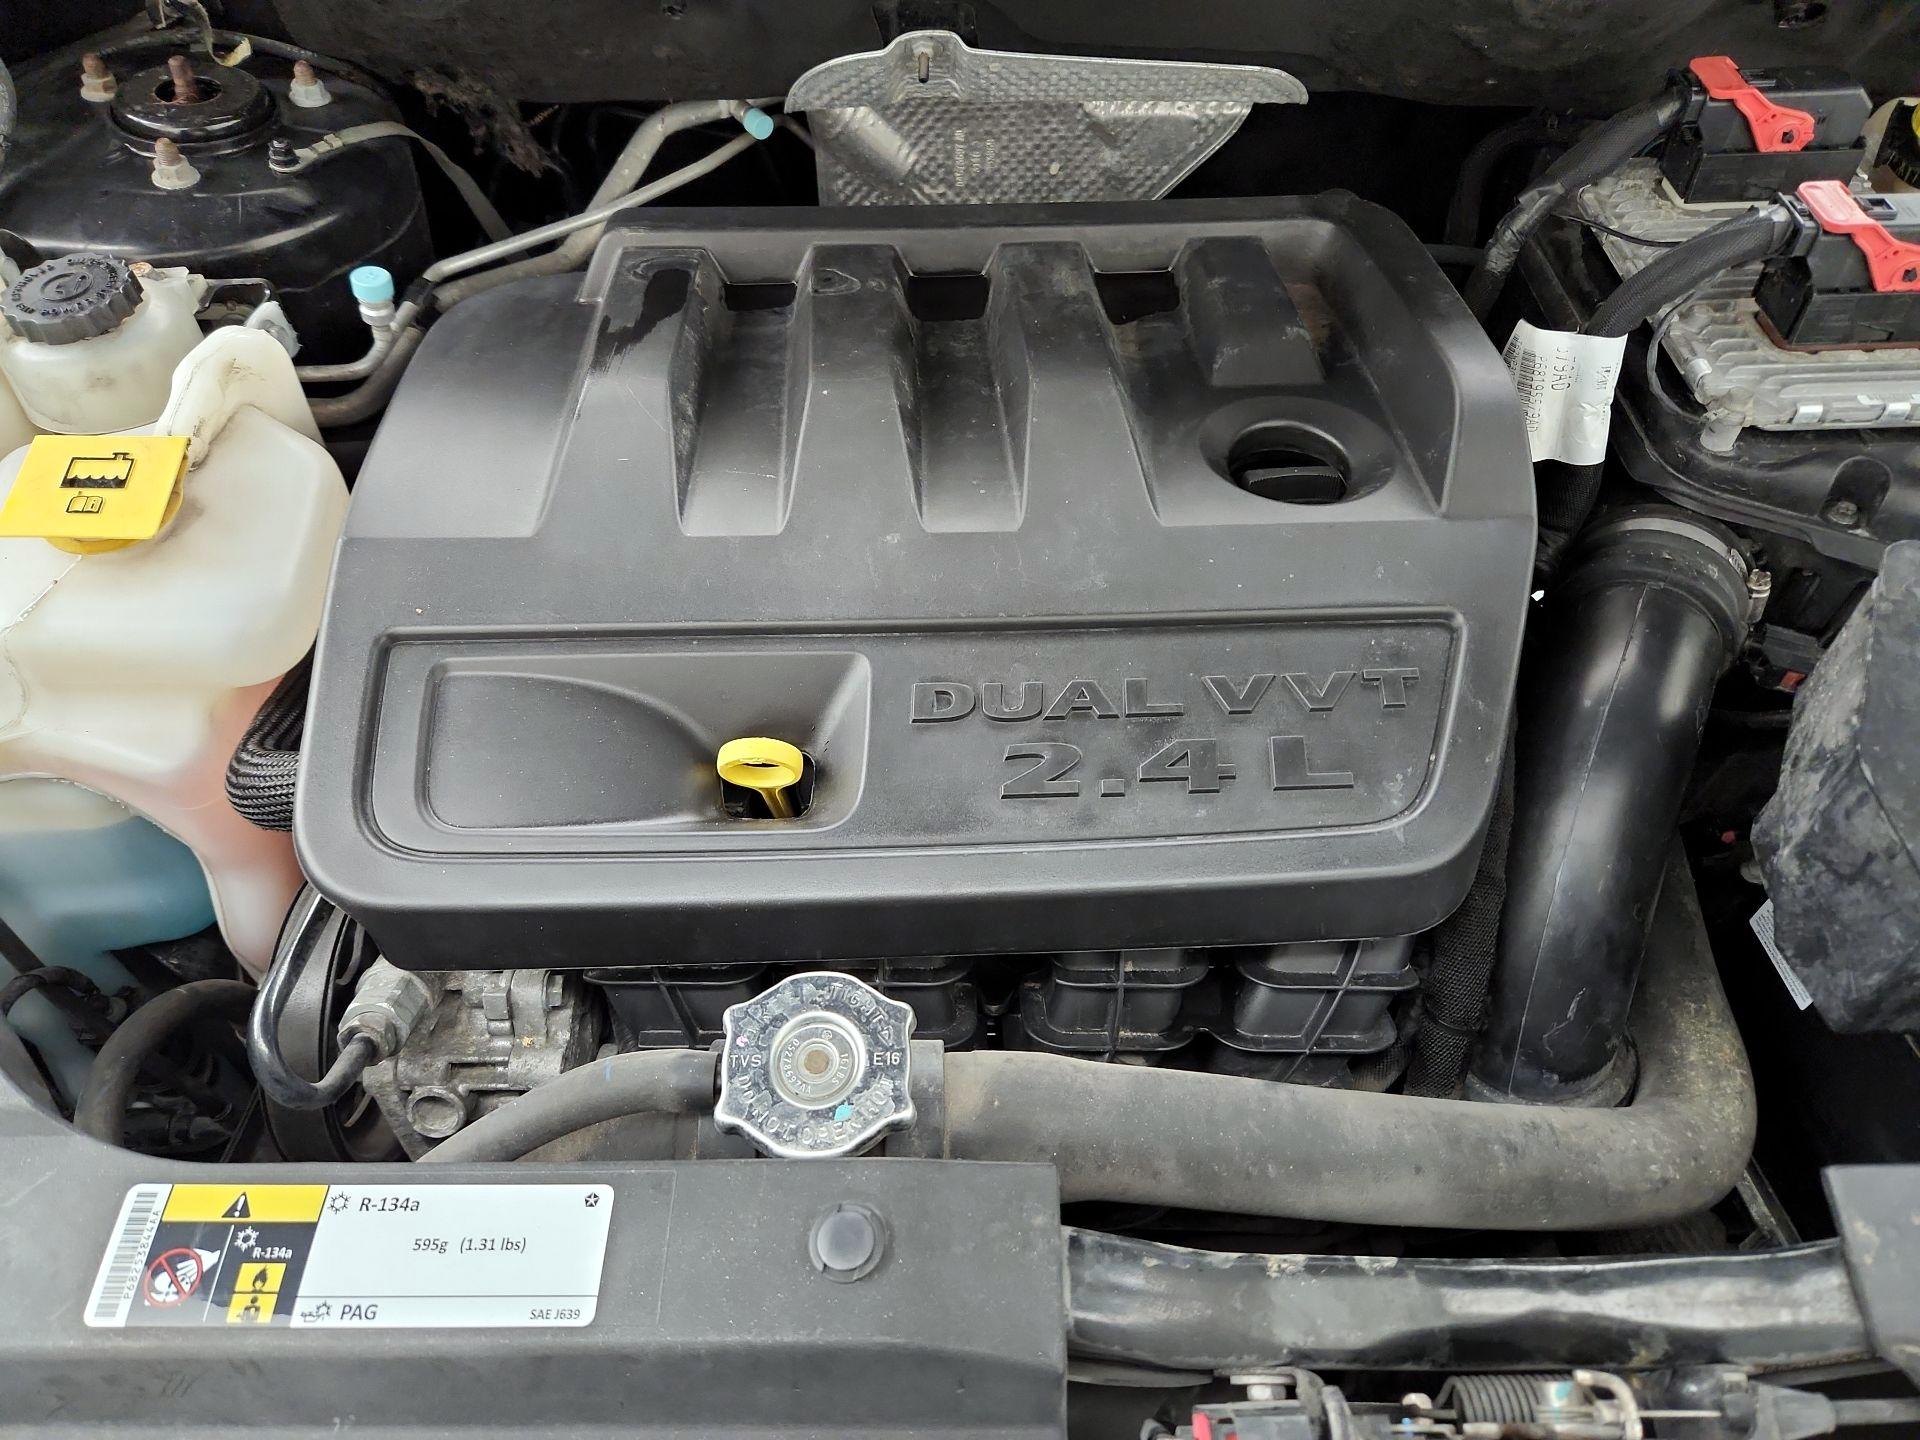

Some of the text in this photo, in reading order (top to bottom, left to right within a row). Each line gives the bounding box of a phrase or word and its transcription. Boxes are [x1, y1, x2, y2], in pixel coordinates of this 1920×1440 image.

[909, 667, 1420, 724] DUAL VVT
[730, 1054, 762, 1068] TVS
[873, 1052, 900, 1066] E16
[359, 1197, 420, 1212] R-134a
[252, 1246, 293, 1259] R-134a
[412, 1237, 527, 1254] 595g (1.31 lbs)
[340, 1304, 378, 1320] PAG
[530, 1309, 581, 1320] SAE J639
